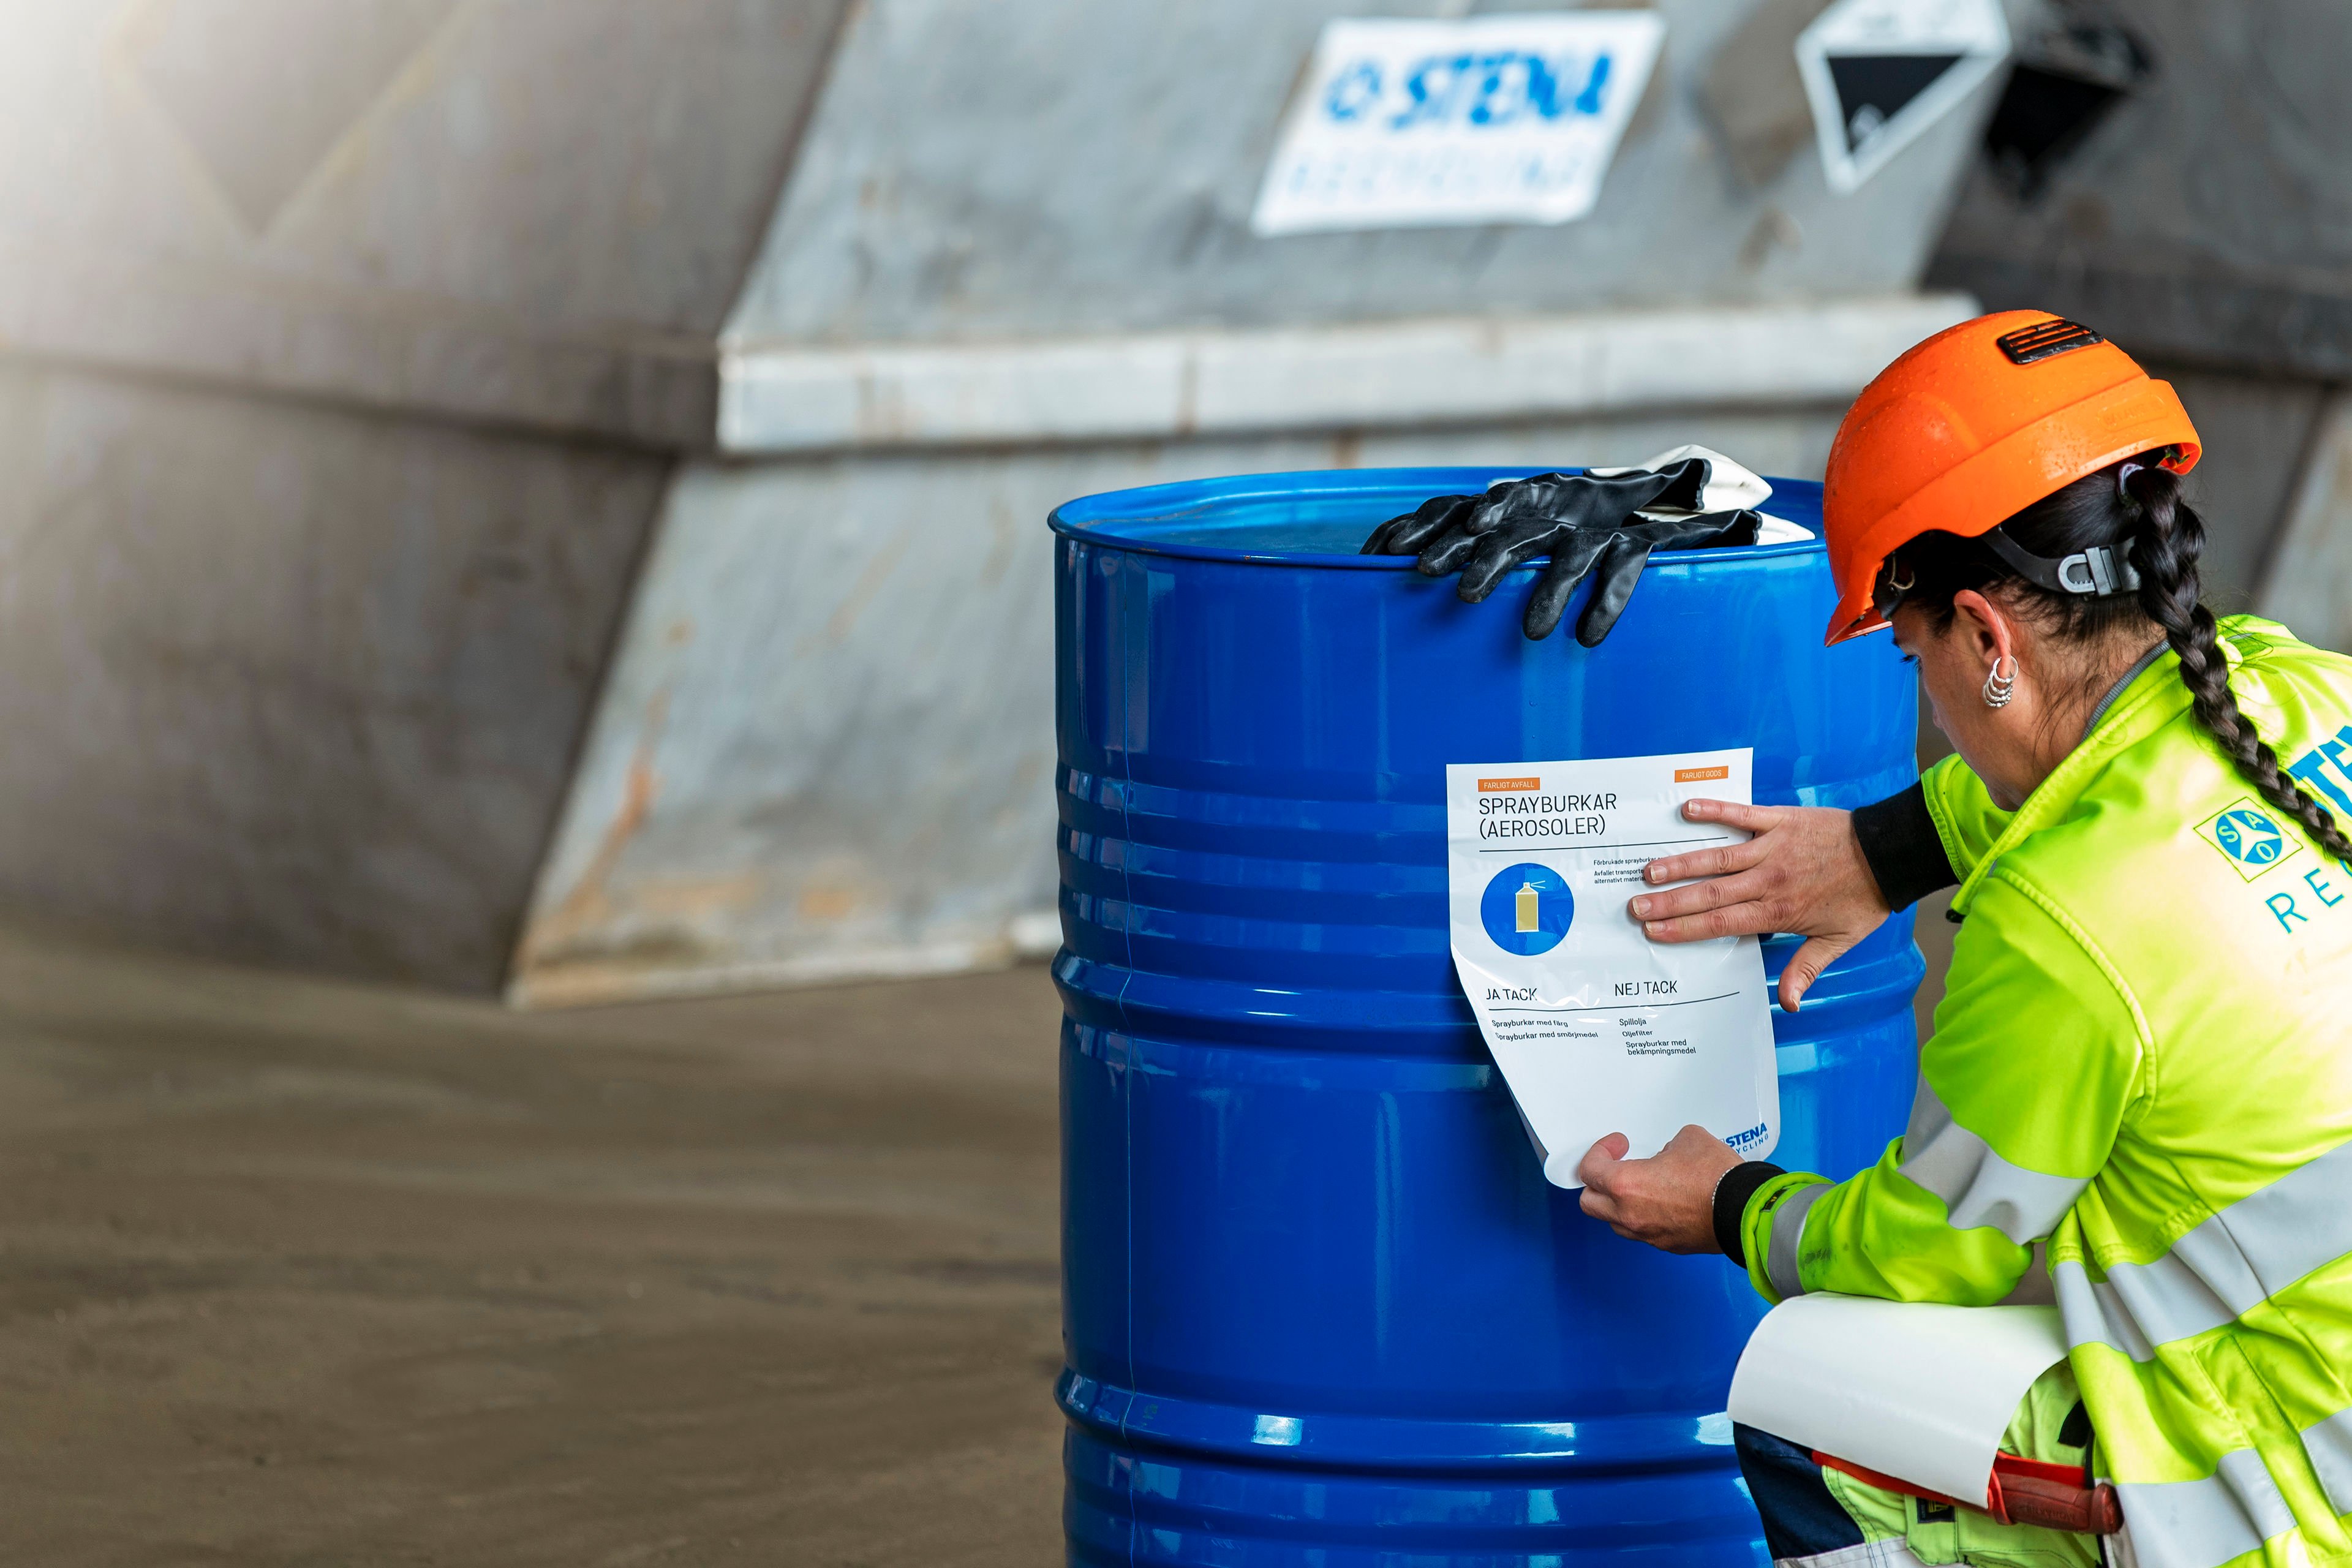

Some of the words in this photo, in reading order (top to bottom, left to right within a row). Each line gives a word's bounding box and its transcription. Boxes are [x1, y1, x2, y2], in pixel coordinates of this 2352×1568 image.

[1479, 793, 1617, 815] SPRAYBURKAR
[1480, 813, 1605, 840] (AEROSOLER)
[1486, 988, 1500, 1000] JA
[1502, 987, 1537, 1001] TACK
[1615, 982, 1640, 996] NEJ
[1644, 981, 1678, 994] TACK
[1491, 1019, 1534, 1028] Sprayburkar
[1619, 1018, 1646, 1027] Spillolja
[1495, 1032, 1537, 1042] Sprayburkar
[1626, 1040, 1670, 1049] Sprayburkar
[1627, 1047, 1697, 1055] bekämpningsmedel
[1725, 1122, 1767, 1147] STENA
